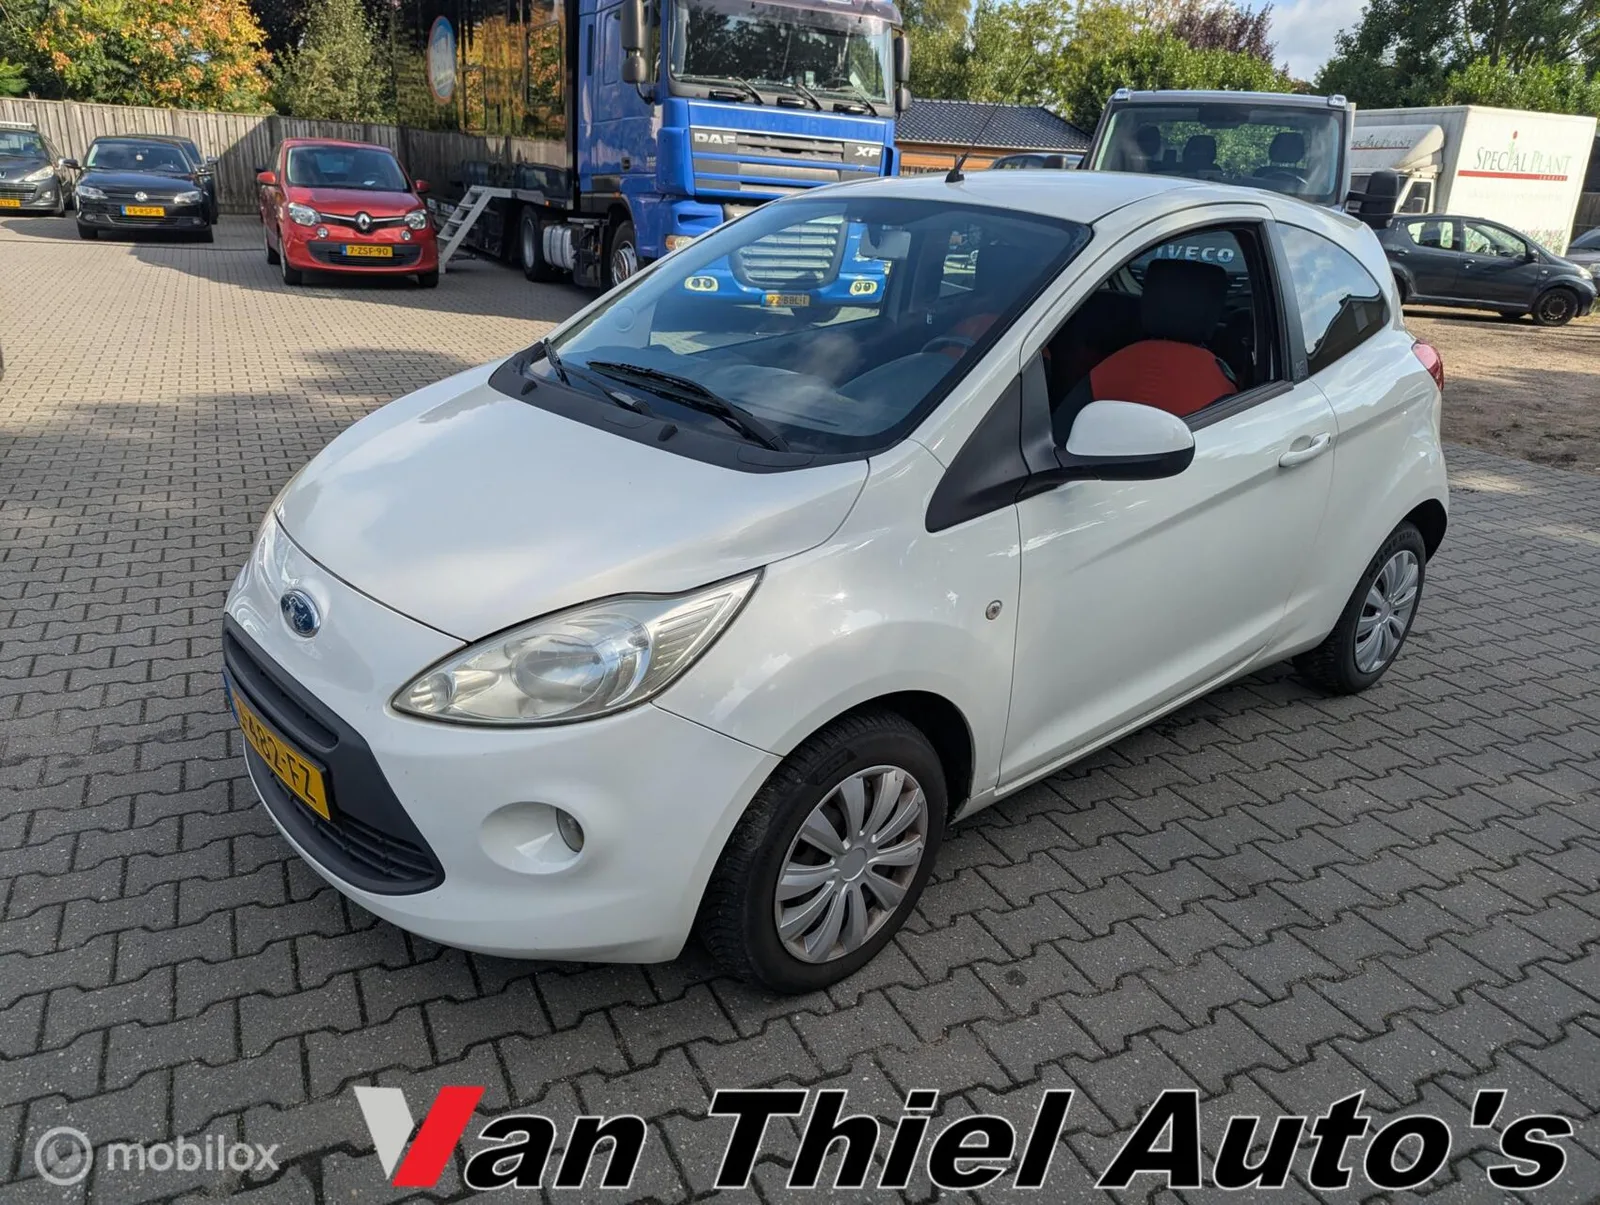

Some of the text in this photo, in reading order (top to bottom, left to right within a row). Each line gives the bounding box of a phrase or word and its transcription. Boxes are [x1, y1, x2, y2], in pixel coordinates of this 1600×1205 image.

[694, 132, 737, 146] DAF
[854, 146, 882, 158] XF
[1473, 145, 1573, 175] SPECIAL PLANT
[348, 246, 389, 256] 7-ZSF-90
[1155, 244, 1235, 263] IVECO
